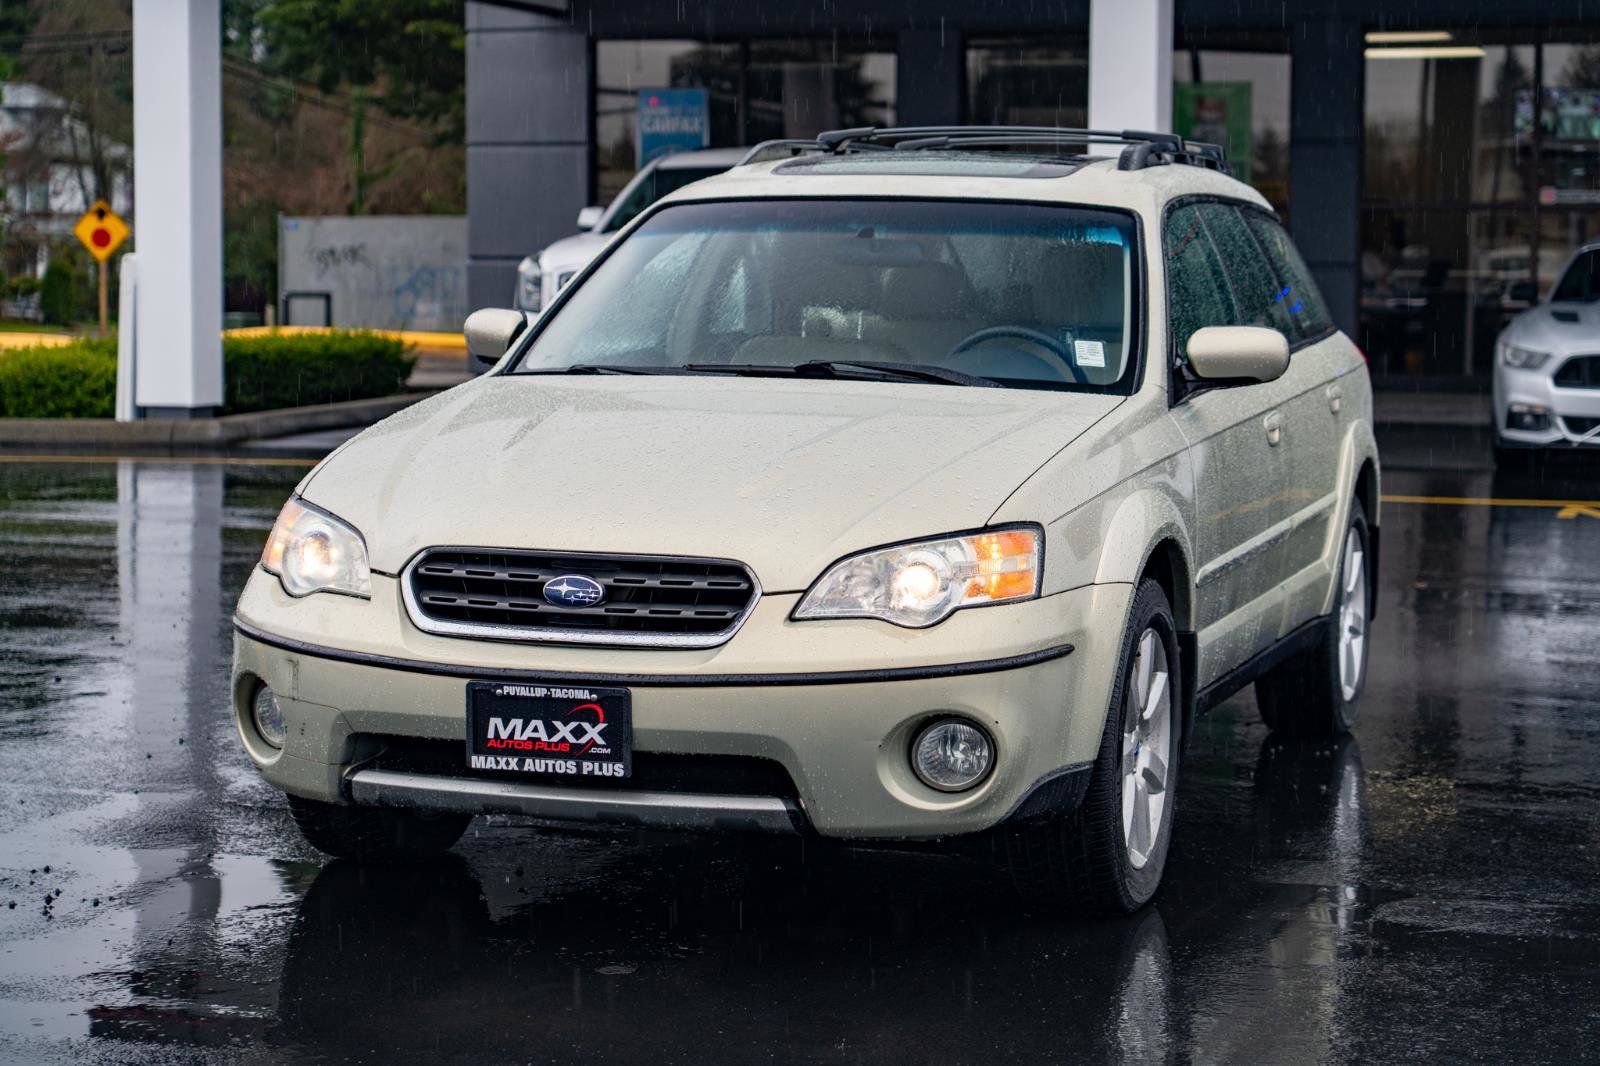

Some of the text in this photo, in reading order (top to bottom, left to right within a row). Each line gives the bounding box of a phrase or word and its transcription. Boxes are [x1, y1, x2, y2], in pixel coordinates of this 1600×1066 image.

[487, 717, 609, 745] MAXX
[487, 739, 570, 752] AUTOS PLUS
[471, 755, 625, 778] MAXX AUTOS PLUS
